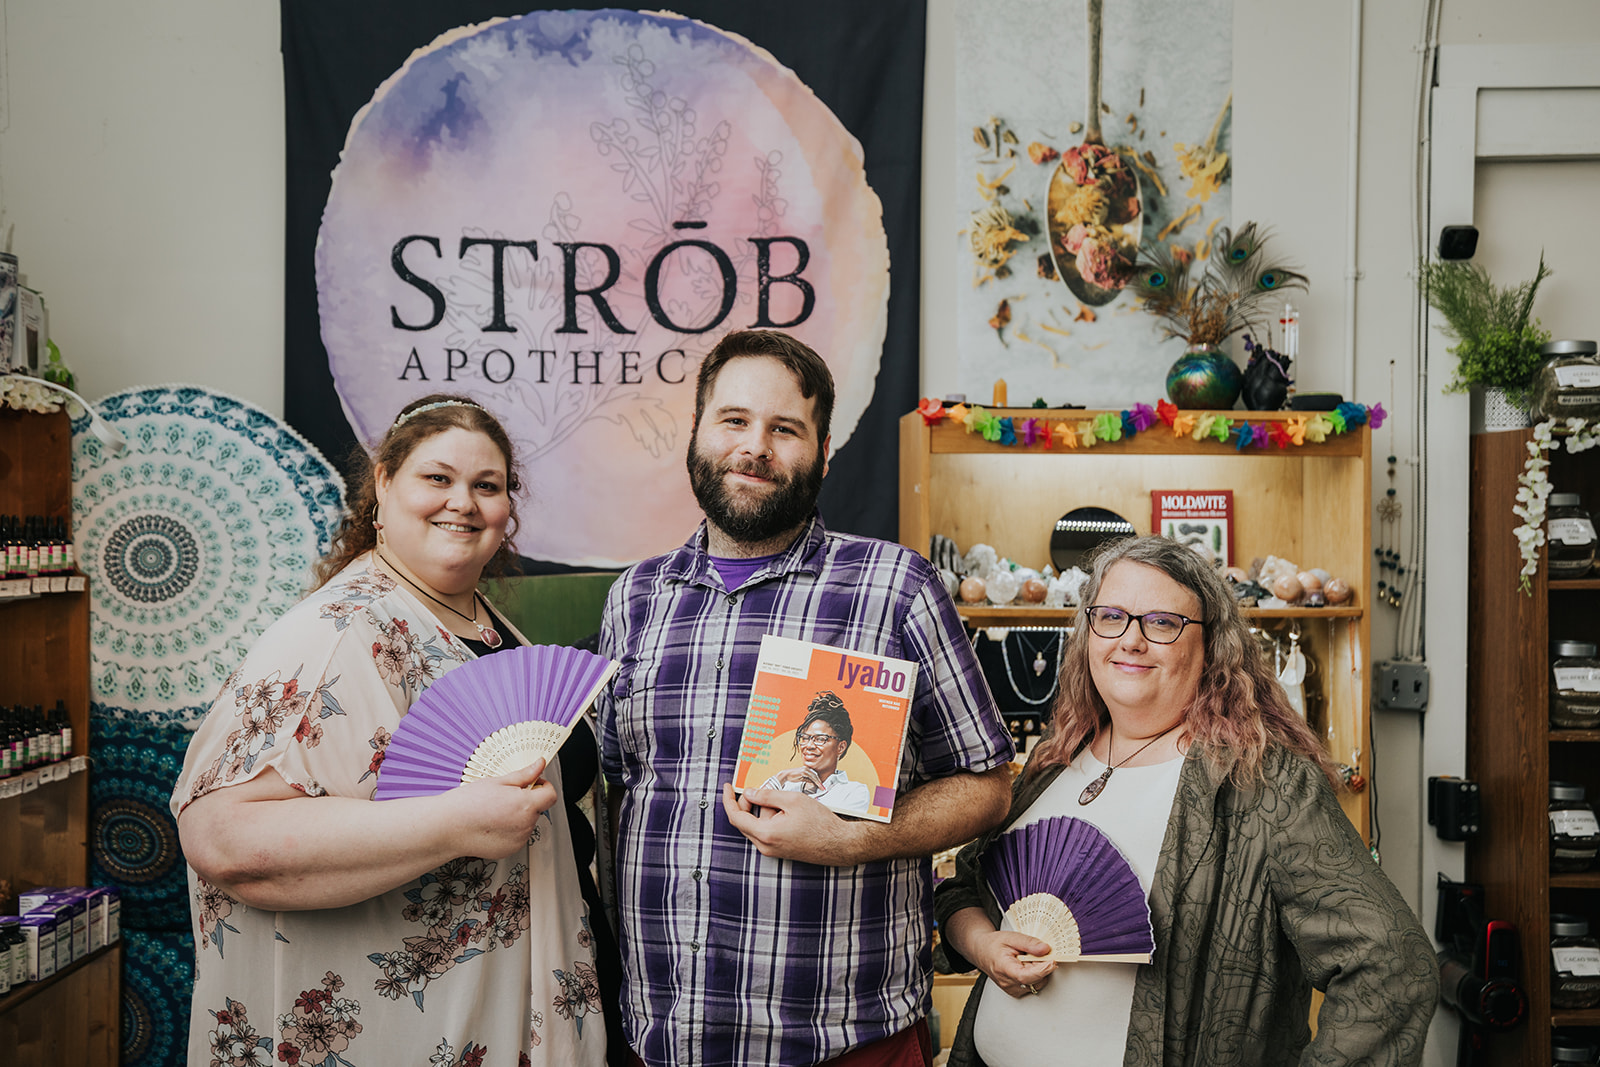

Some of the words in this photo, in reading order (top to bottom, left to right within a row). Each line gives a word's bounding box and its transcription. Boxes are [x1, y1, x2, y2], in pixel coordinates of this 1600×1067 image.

[390, 221, 816, 334] STRŌB
[397, 346, 686, 385] APOTHEC
[1161, 495, 1227, 510] MOLDAVITE
[837, 654, 906, 693] Iyabo
